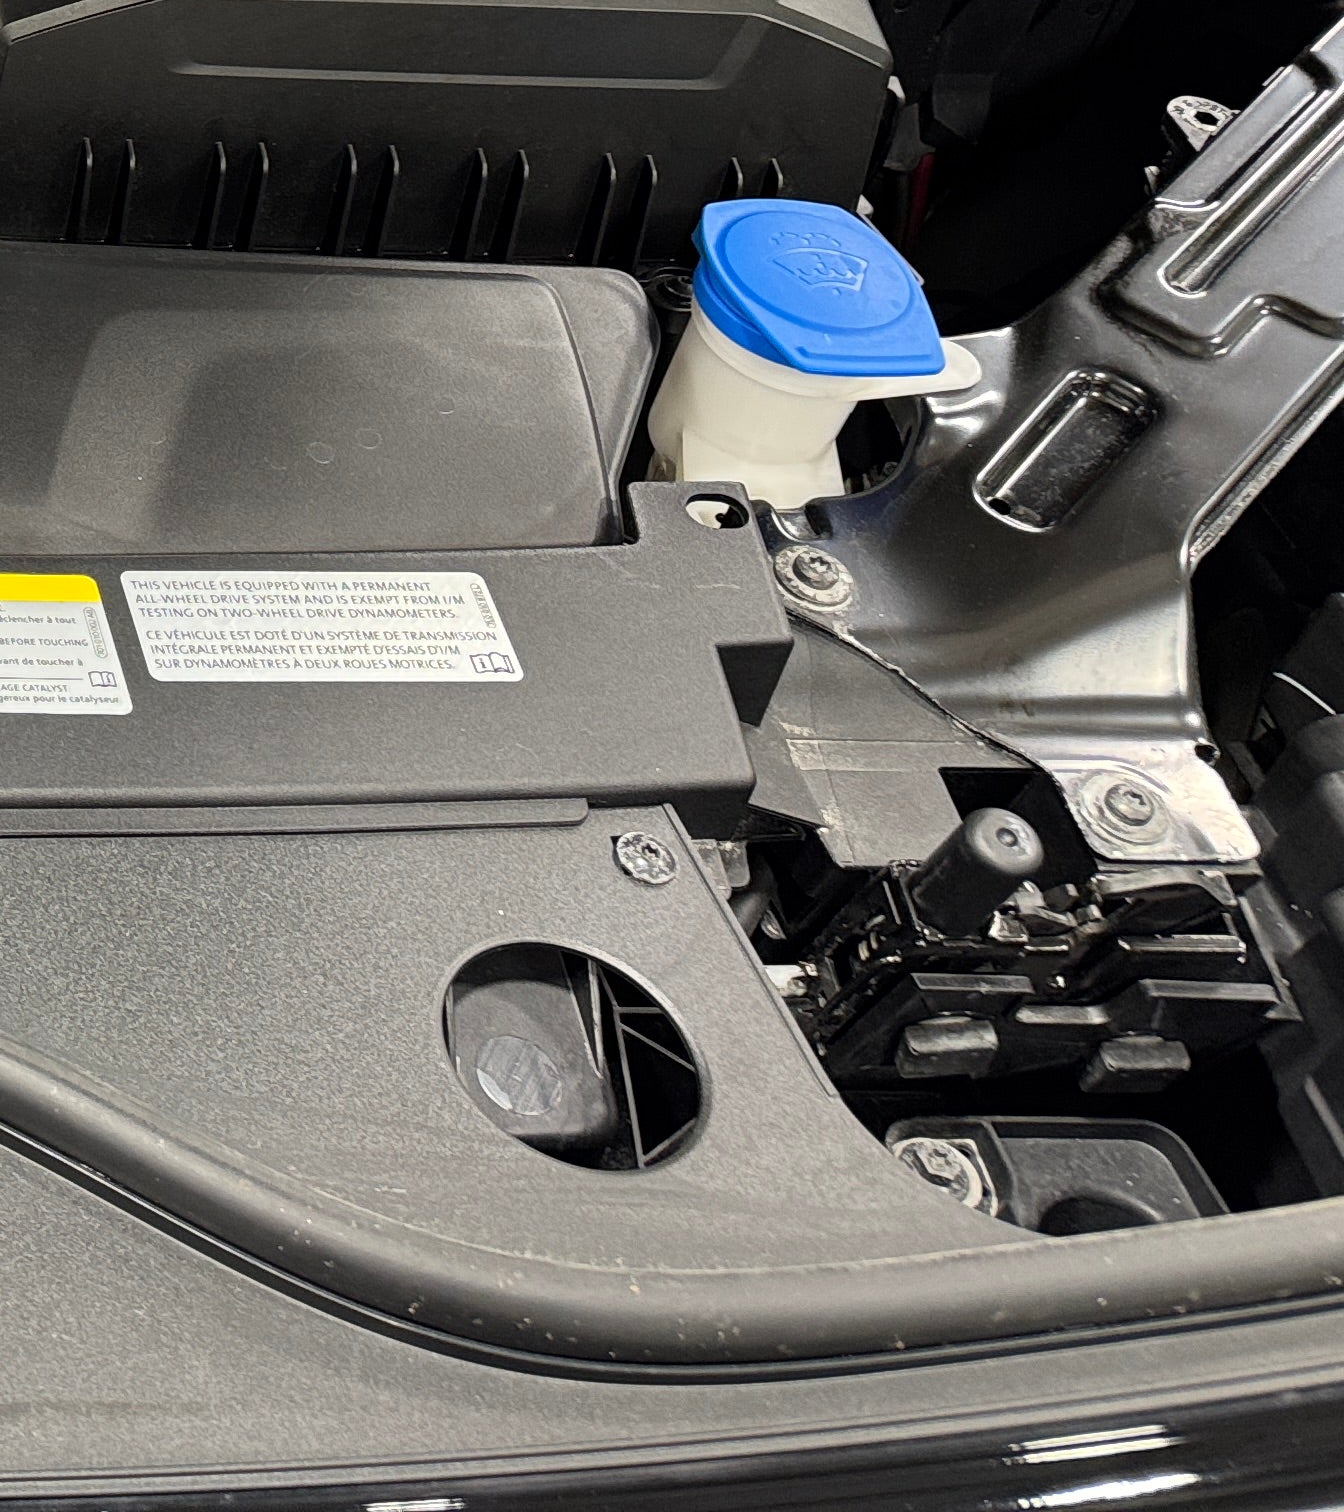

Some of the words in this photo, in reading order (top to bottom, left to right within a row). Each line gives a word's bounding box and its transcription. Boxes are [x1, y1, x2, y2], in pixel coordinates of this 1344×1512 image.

[129, 580, 161, 591] THIS
[161, 580, 218, 591] VEHICLE
[219, 580, 232, 591] IS
[233, 580, 300, 592] EQUIPPED
[300, 581, 339, 591] WITH
[341, 581, 352, 592] A
[351, 581, 431, 592] PERMANENT
[135, 593, 209, 604] ALL-WHEEL
[209, 594, 250, 605] DRIVE
[251, 594, 301, 605] SYSTEM
[304, 594, 334, 605] AND
[335, 594, 349, 605] IS
[350, 594, 400, 605] EXEMPT
[402, 594, 441, 605] FROM
[442, 594, 466, 605] I/M
[137, 607, 195, 618] TESTING
[196, 607, 219, 618] ON
[219, 607, 305, 619] TWO-WHEEL
[305, 608, 346, 619] DRIVE
[145, 630, 164, 641] CE
[229, 630, 251, 641] EST
[290, 630, 326, 641] D'UN
[382, 630, 402, 641] DE
[401, 630, 498, 642] TRANSMISSION
[219, 644, 297, 655] PERMANENT
[298, 644, 314, 655] ET
[154, 658, 182, 669] SUR
[303, 658, 342, 670] DEUX
[342, 658, 388, 670] ROUES
